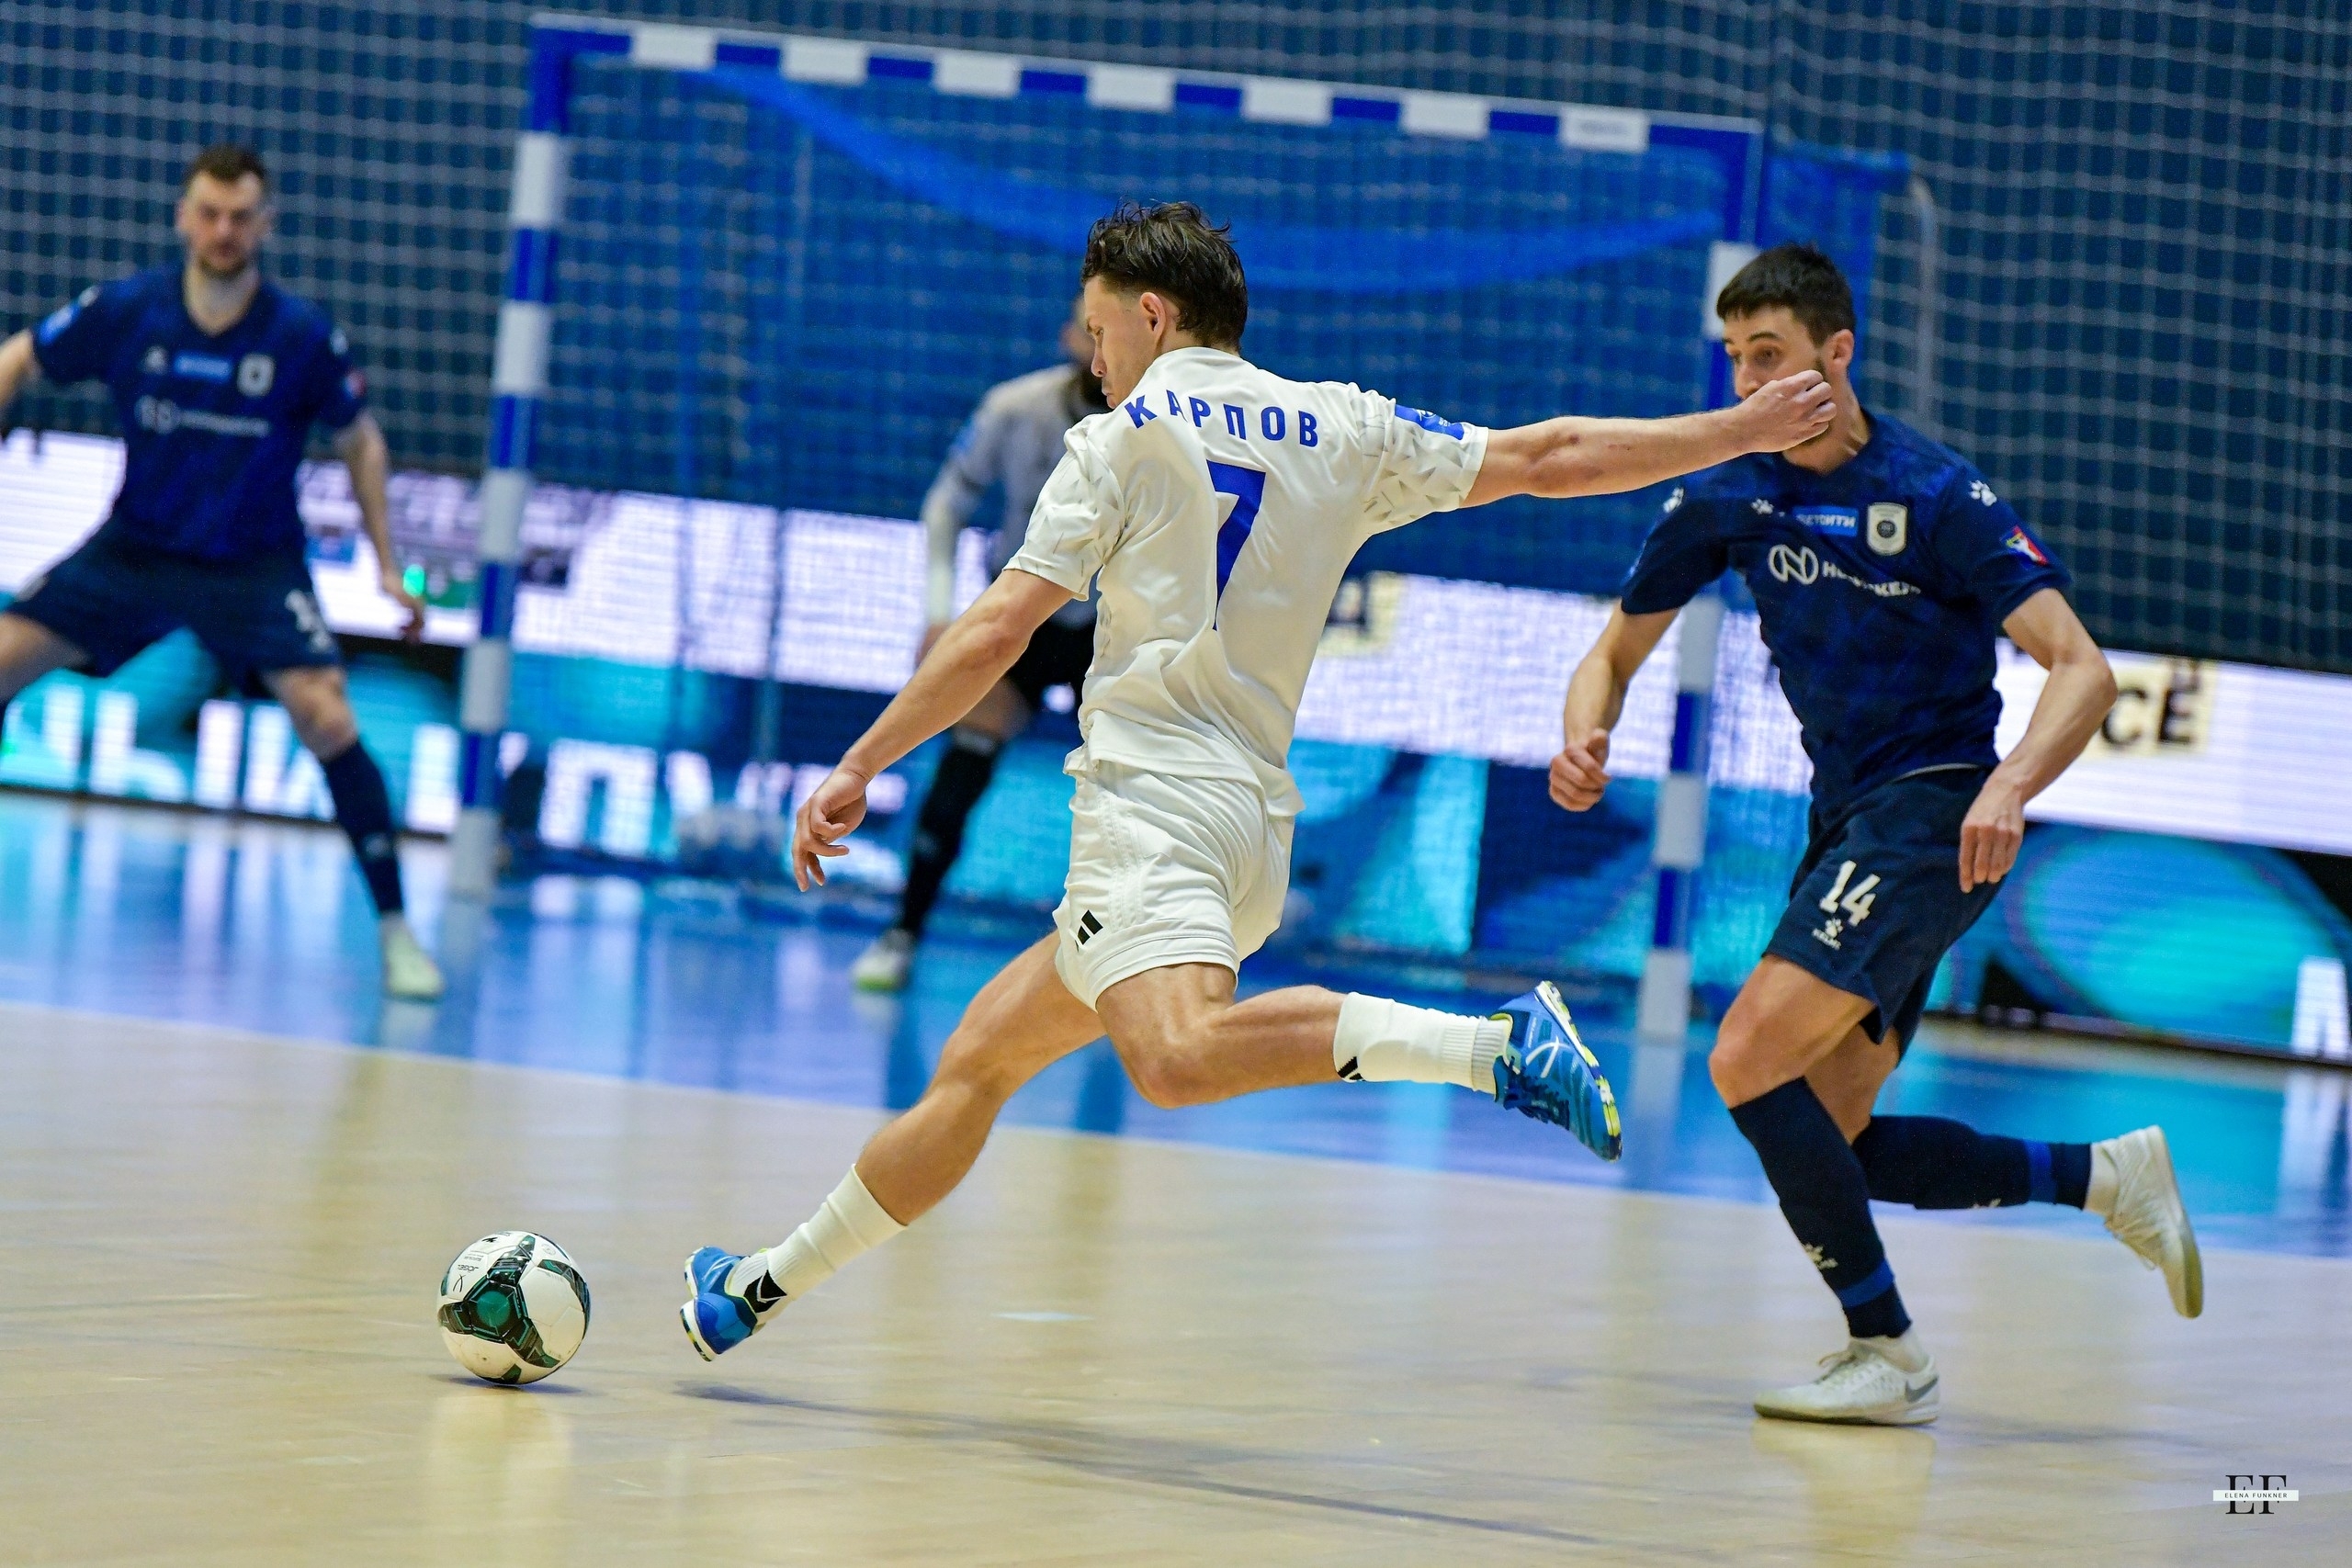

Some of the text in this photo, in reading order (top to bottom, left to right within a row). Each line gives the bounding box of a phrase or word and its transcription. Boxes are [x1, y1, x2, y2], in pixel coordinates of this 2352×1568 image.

[1124, 389, 1318, 447] КАРПОВ
[1206, 458, 1266, 631] 7
[1819, 860, 1882, 927] 14
